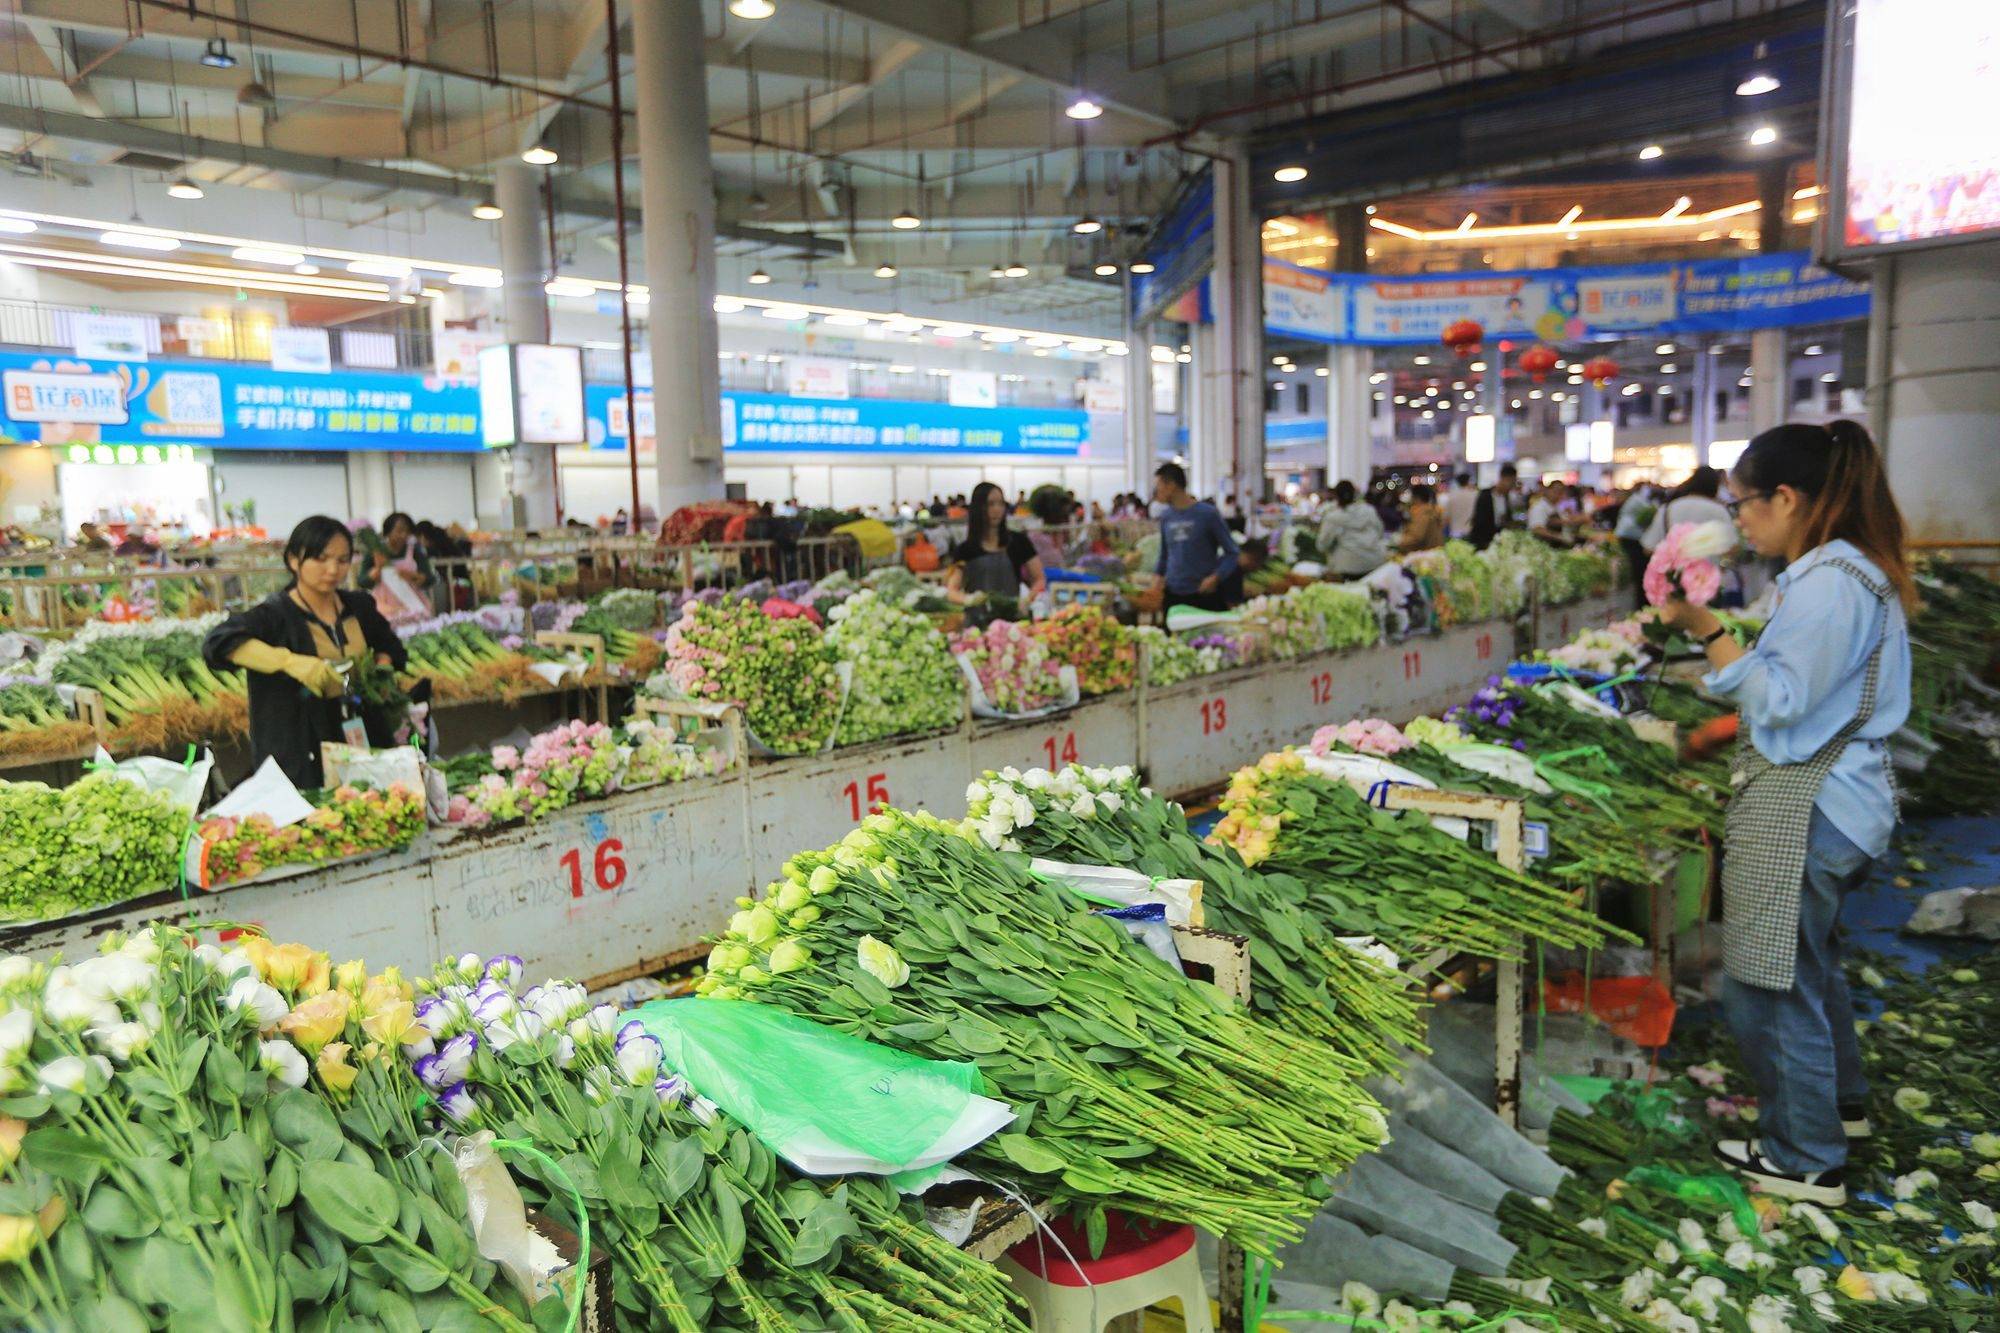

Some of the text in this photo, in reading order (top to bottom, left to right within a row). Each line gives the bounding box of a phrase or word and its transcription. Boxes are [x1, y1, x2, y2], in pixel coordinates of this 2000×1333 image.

[1402, 650, 1422, 680] 11
[1310, 671, 1333, 704] 12
[1200, 696, 1227, 737] 13
[1043, 731, 1079, 772] 14
[843, 773, 890, 821] 15
[559, 838, 628, 899] 16
